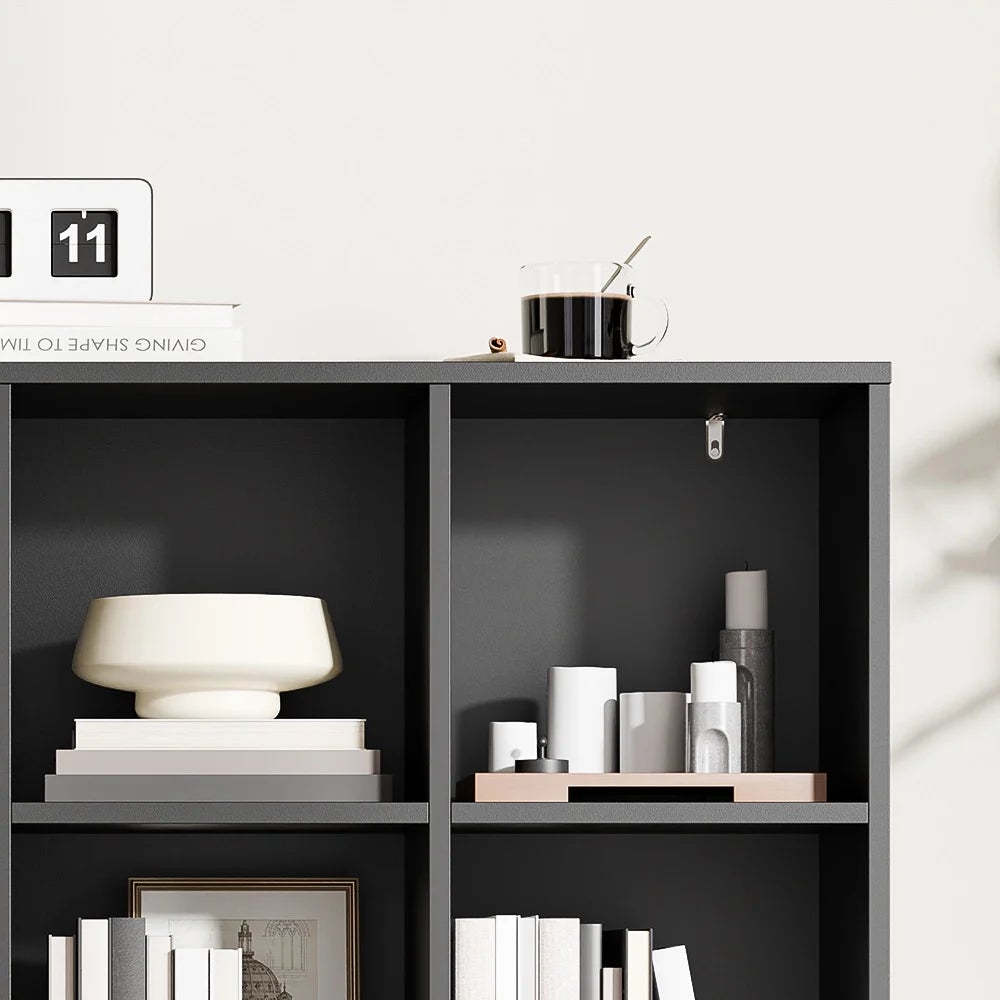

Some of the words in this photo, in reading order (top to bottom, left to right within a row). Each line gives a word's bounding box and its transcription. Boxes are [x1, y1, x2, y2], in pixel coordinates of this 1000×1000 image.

[59, 223, 106, 263] 11
[37, 337, 62, 352] TO
[68, 337, 128, 352] SHAPE
[134, 337, 207, 352] GIVING
